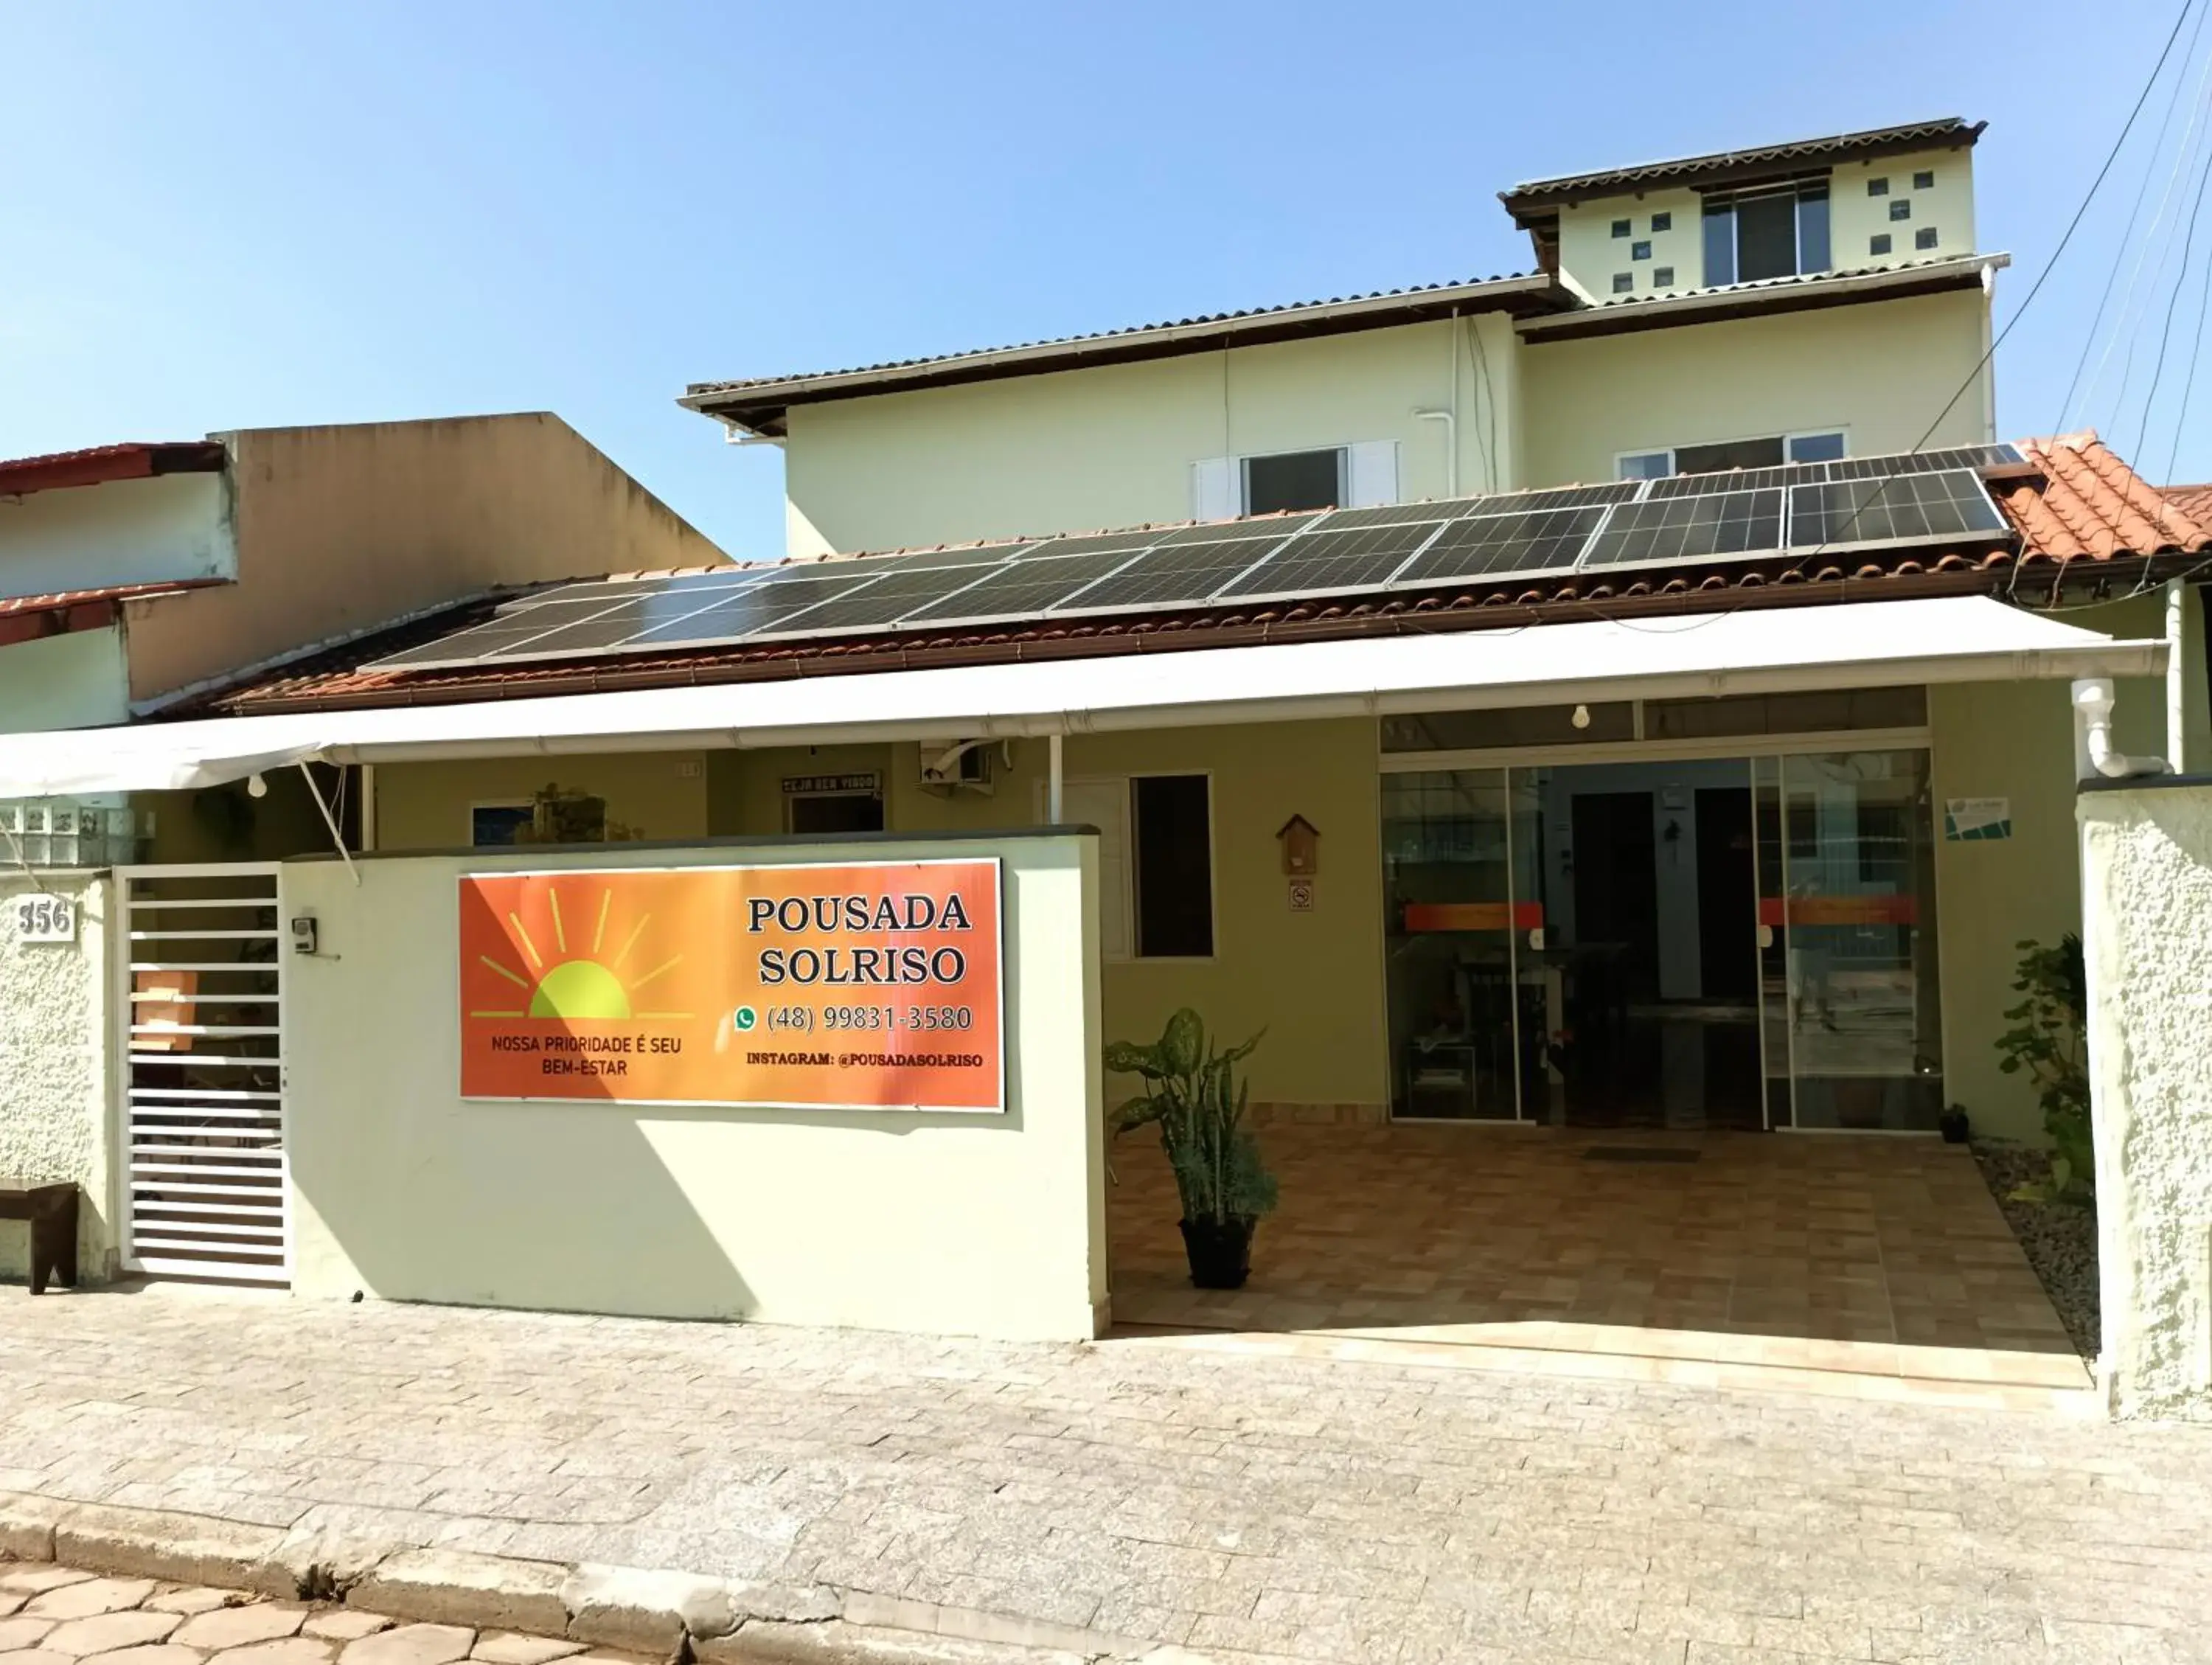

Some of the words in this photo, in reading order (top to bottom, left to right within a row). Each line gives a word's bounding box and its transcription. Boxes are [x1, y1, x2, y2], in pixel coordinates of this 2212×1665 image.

[747, 893, 972, 932] POUSADA
[759, 947, 967, 984] SOLRISO
[768, 1006, 815, 1032] (48)
[823, 1005, 972, 1030] 99831-3580
[492, 1036, 540, 1052] NOSSA
[545, 1036, 631, 1052] PRIORIDADE
[636, 1034, 644, 1053] É
[650, 1037, 681, 1054] SEU
[542, 1058, 627, 1076] BEM-ESTAR
[747, 1052, 835, 1066] INSTAGRAM:
[838, 1054, 983, 1068] @POUSADASOLRISO
